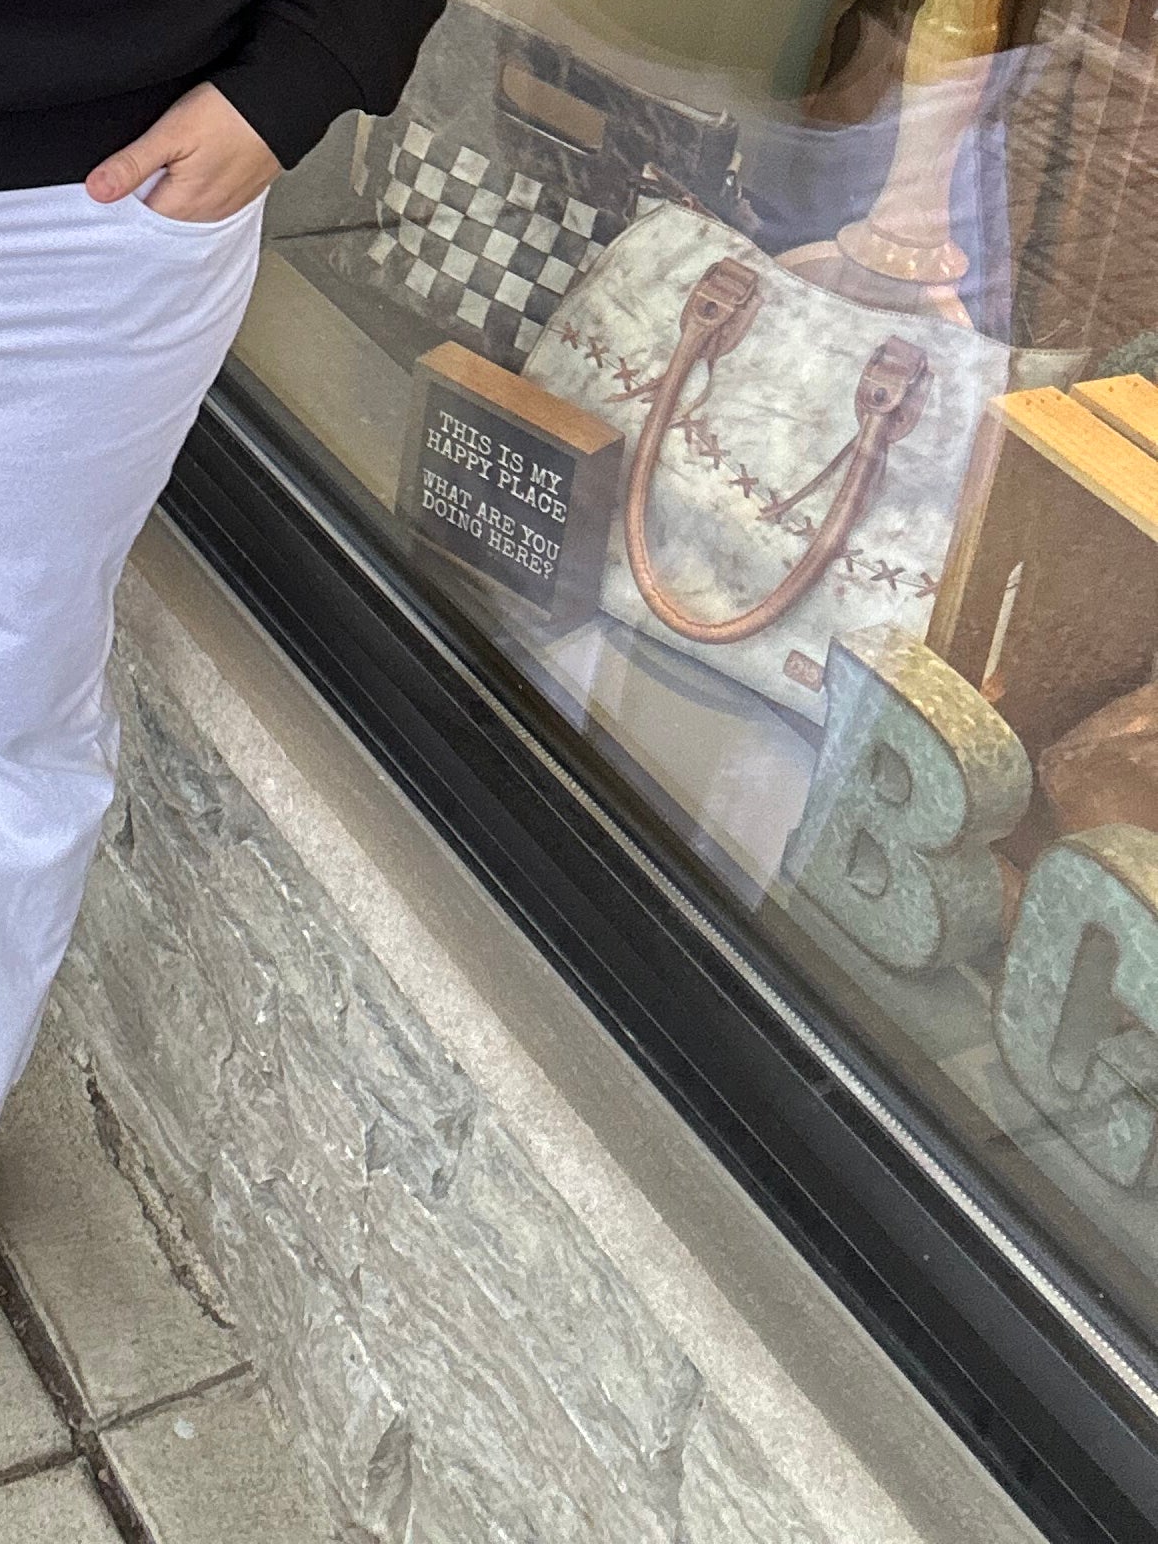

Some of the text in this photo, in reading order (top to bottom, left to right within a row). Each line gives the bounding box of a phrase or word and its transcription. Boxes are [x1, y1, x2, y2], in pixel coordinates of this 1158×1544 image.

[426, 427, 567, 523] HAPPY PLACE
[439, 410, 563, 496] THIS IS MY
[422, 468, 560, 561] WHAT ARE YOU
[422, 489, 555, 580] DOING HERE?
